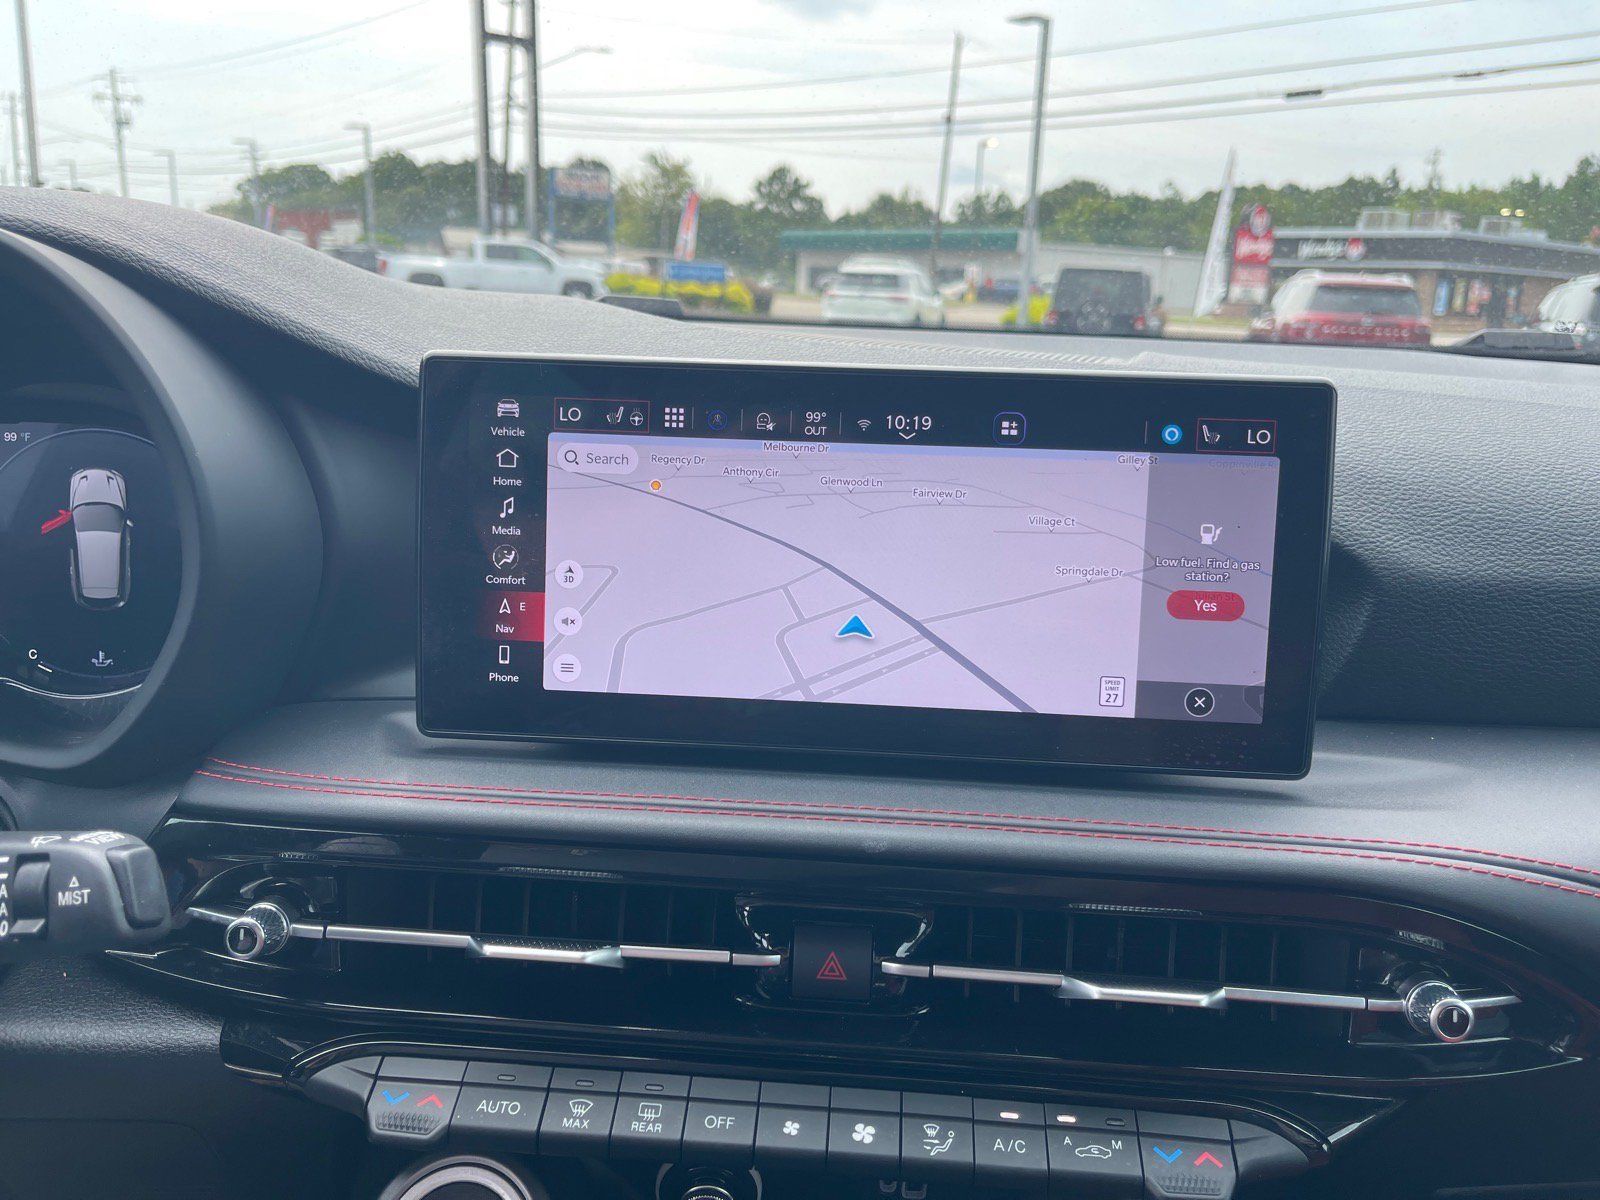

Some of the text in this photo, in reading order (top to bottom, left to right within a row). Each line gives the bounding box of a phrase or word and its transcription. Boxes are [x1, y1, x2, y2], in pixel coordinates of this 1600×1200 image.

[559, 406, 582, 422] LO
[885, 415, 932, 431] 10:19
[490, 426, 525, 437] Vehicle
[804, 426, 828, 436] OUT
[3, 432, 18, 442] 99
[1247, 429, 1271, 445] LO
[763, 442, 830, 453] Melbourne Dr
[586, 452, 629, 466] Search
[650, 454, 706, 467] Regency Dr
[1117, 454, 1158, 466] Gilley St
[722, 466, 780, 478] Anthony Cir
[493, 476, 522, 486] Home
[820, 476, 883, 487] Glenwood Ln
[912, 488, 967, 498] Fairview Dr
[1029, 515, 1075, 527] Village Ct
[492, 525, 521, 536] Media
[1155, 556, 1260, 572] Low fuel. Find a gas
[1055, 566, 1124, 577] Springdale Dr
[1185, 571, 1229, 583] station?
[485, 575, 526, 585] Comfort
[563, 575, 575, 584] 3D
[519, 602, 526, 611] E
[1194, 600, 1217, 612] Yes
[495, 624, 515, 634] Nav
[28, 649, 38, 659] C
[489, 673, 520, 683] Phone
[1105, 694, 1119, 704] 27
[57, 889, 92, 906] MIST
[476, 1099, 521, 1115] AUTO
[562, 1117, 590, 1129] MAX
[704, 1114, 736, 1130] OFF
[631, 1122, 663, 1134] REAR
[993, 1137, 1027, 1155] A/C
[1063, 1136, 1072, 1146] A
[1111, 1140, 1123, 1150] M
